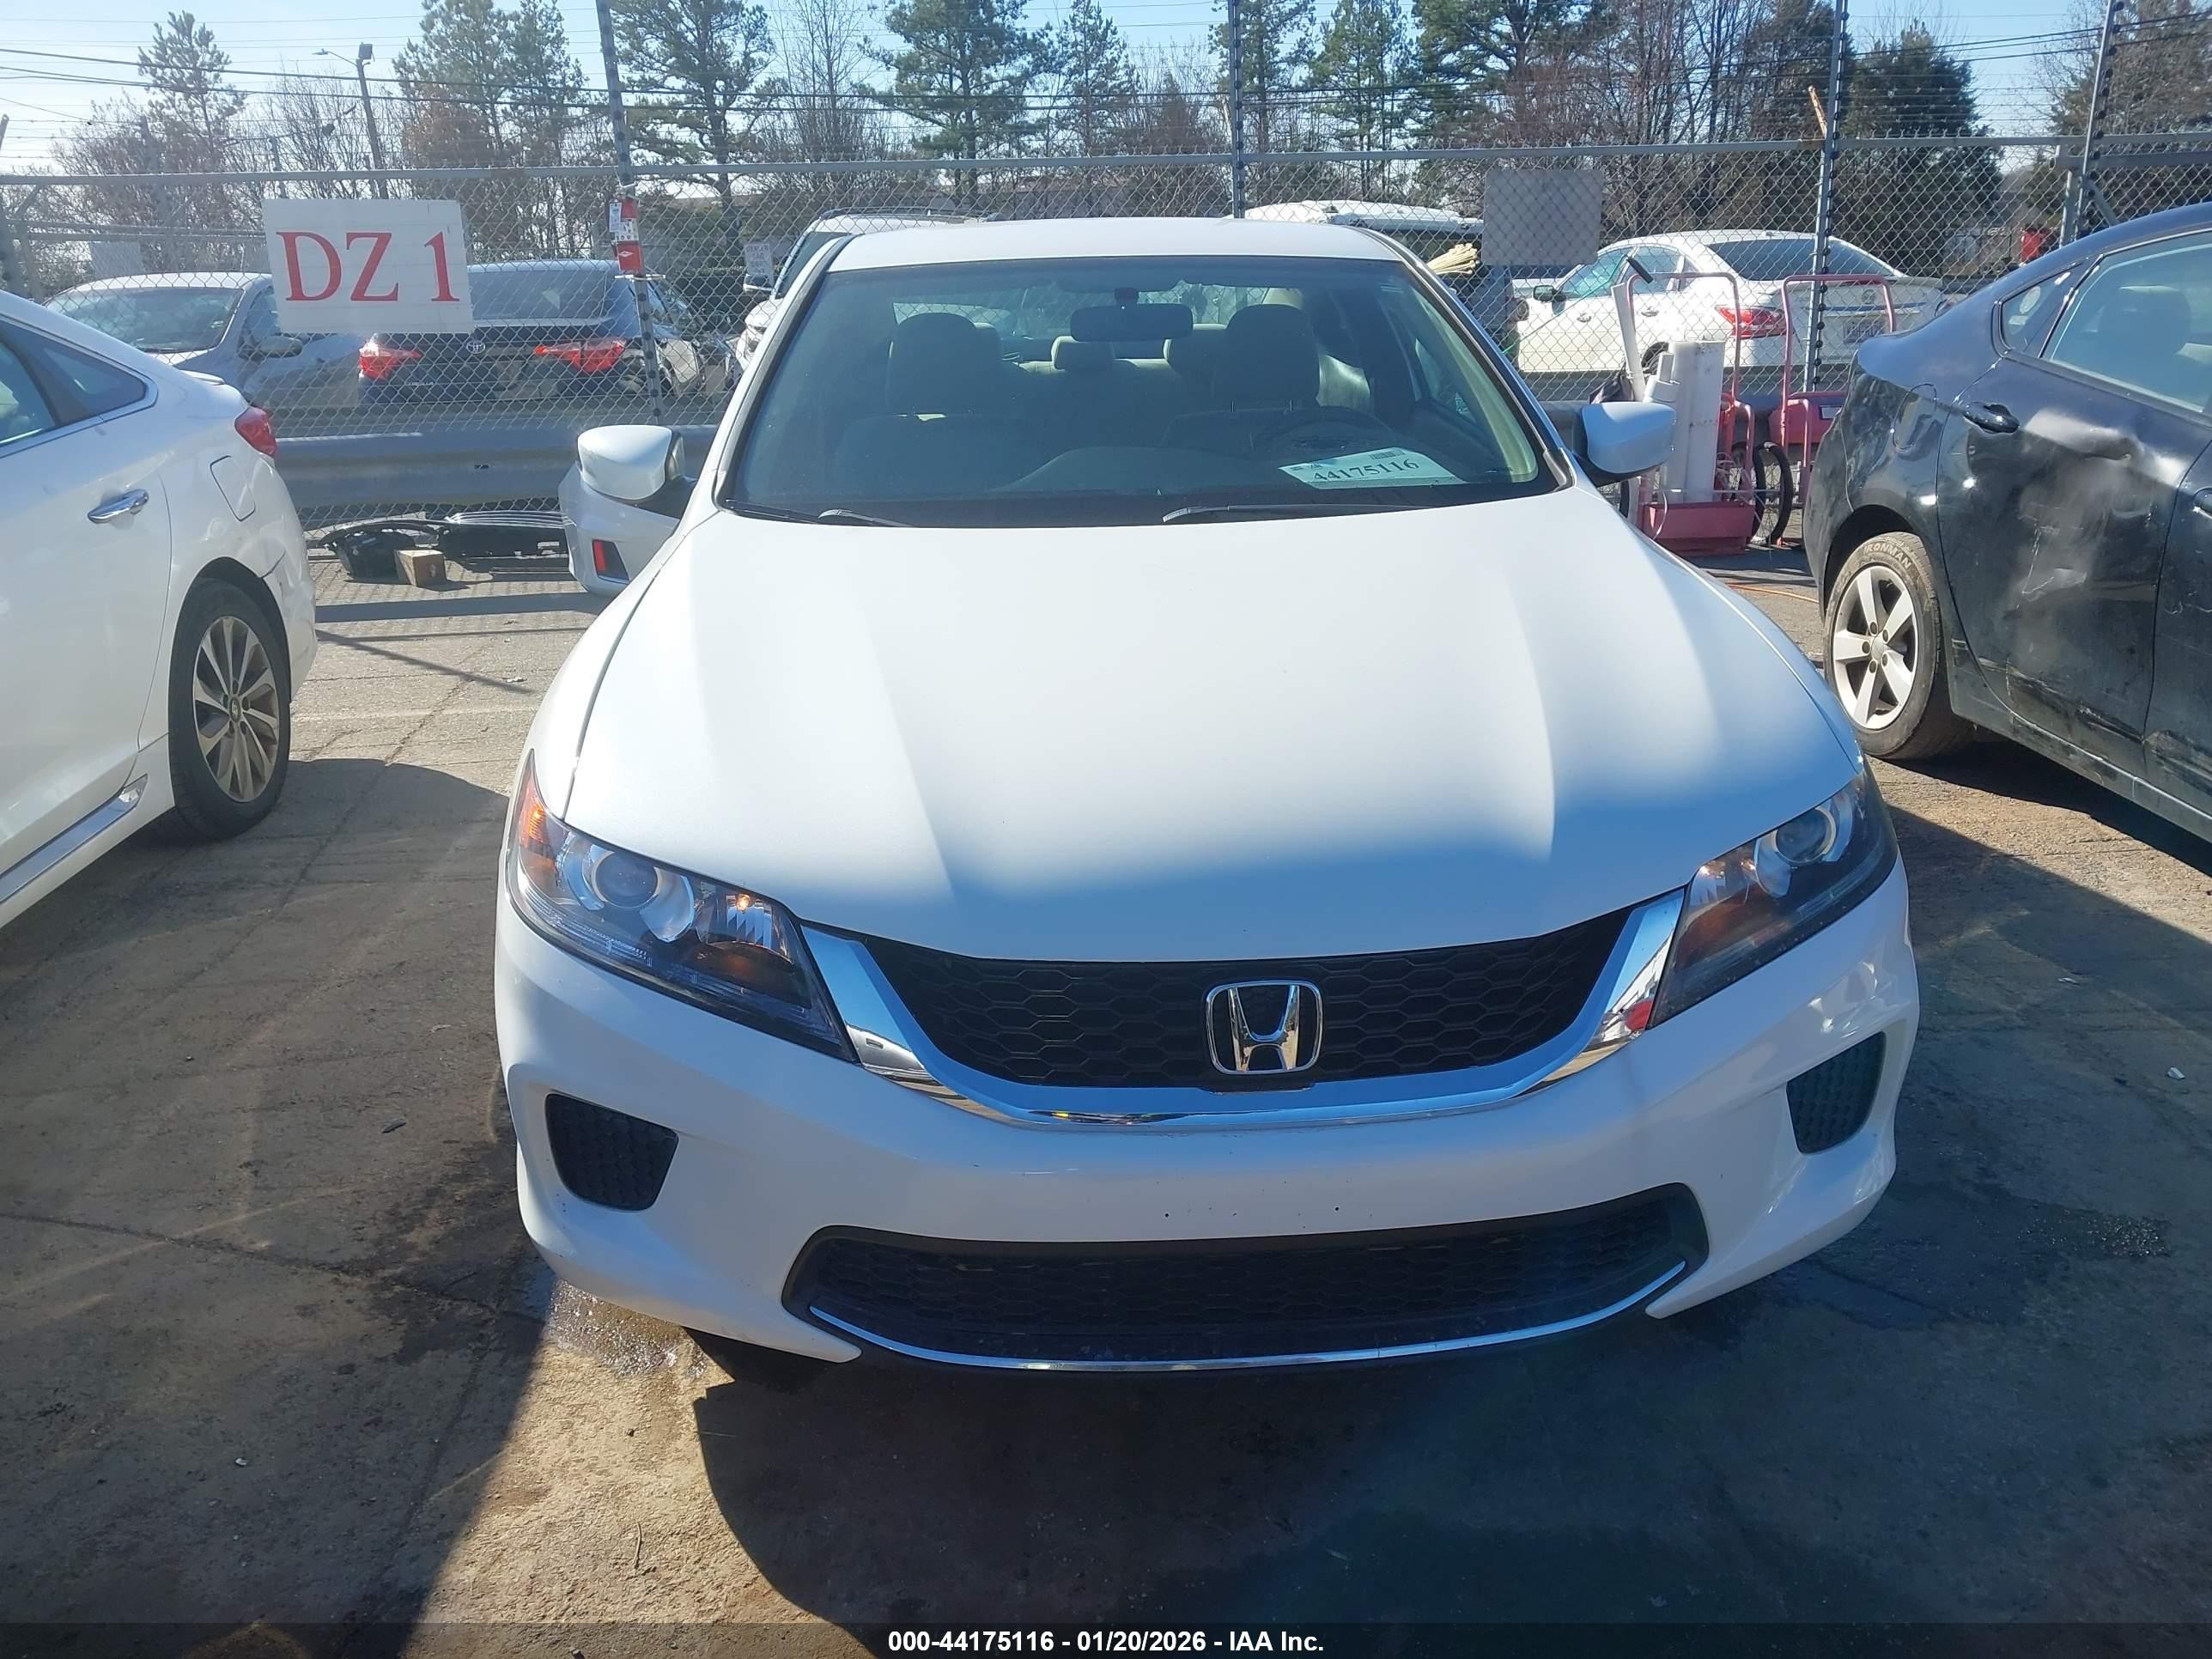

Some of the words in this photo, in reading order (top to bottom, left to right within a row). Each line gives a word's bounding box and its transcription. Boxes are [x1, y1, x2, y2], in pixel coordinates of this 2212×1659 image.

[276, 231, 399, 302] DZ
[424, 231, 460, 302] 1
[1313, 458, 1420, 483] 44175116
[1863, 541, 1912, 569] IRONMAN
